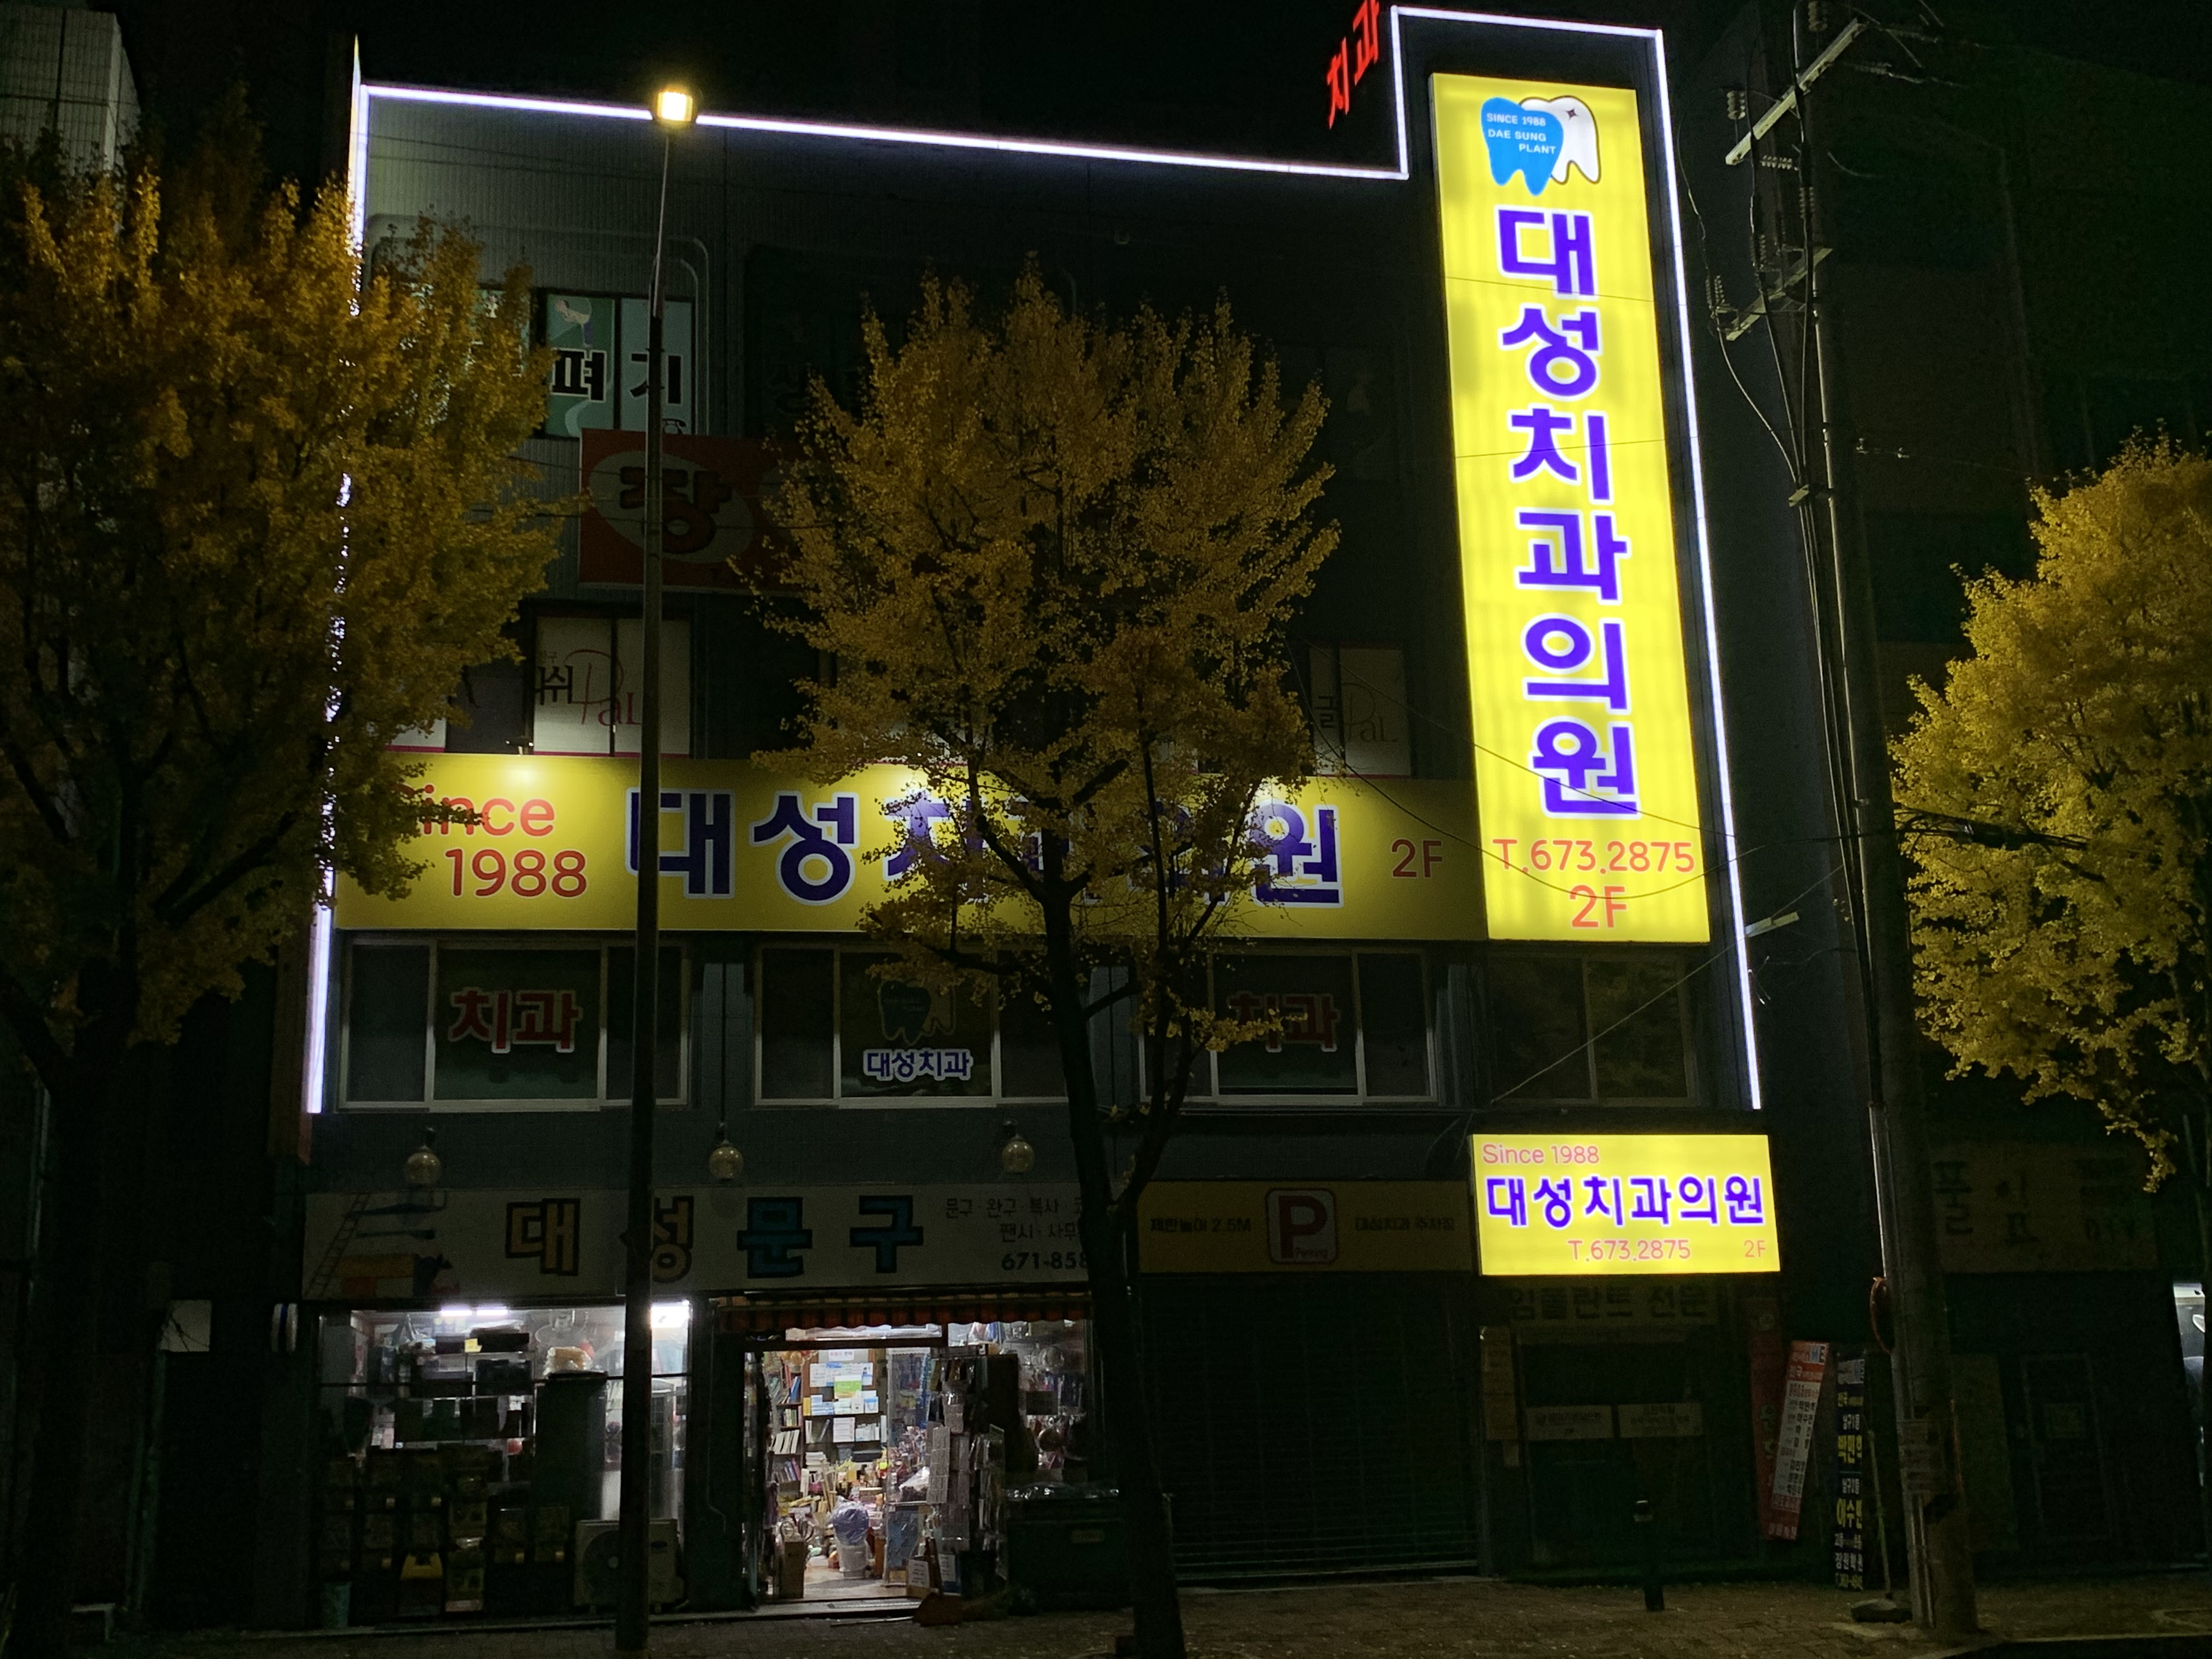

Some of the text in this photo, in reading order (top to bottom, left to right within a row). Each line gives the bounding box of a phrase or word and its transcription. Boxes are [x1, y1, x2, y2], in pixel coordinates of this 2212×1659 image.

[1326, 0, 1380, 129] 치과
[1486, 112, 1547, 127] SINCE 1988
[1487, 128, 1547, 142] DAE SUNG
[1518, 143, 1557, 155] PLANT
[1496, 205, 1641, 819] 대성치과의원
[388, 780, 556, 837] ince
[444, 848, 588, 898] 1988
[1391, 838, 1443, 878] 2F
[1491, 837, 1696, 876] T.673.2875
[1568, 883, 1628, 929] 2F
[449, 988, 582, 1052] 치과
[1227, 991, 1341, 1052] 치과
[864, 1048, 972, 1081] 대성치과
[1481, 1143, 1600, 1165] Since 1988
[1485, 1175, 1766, 1229] 대성치과의원
[1212, 1217, 1252, 1233] 2.5M
[1278, 1195, 1327, 1259] P
[1566, 1239, 1767, 1262] T.673.2875 2F
